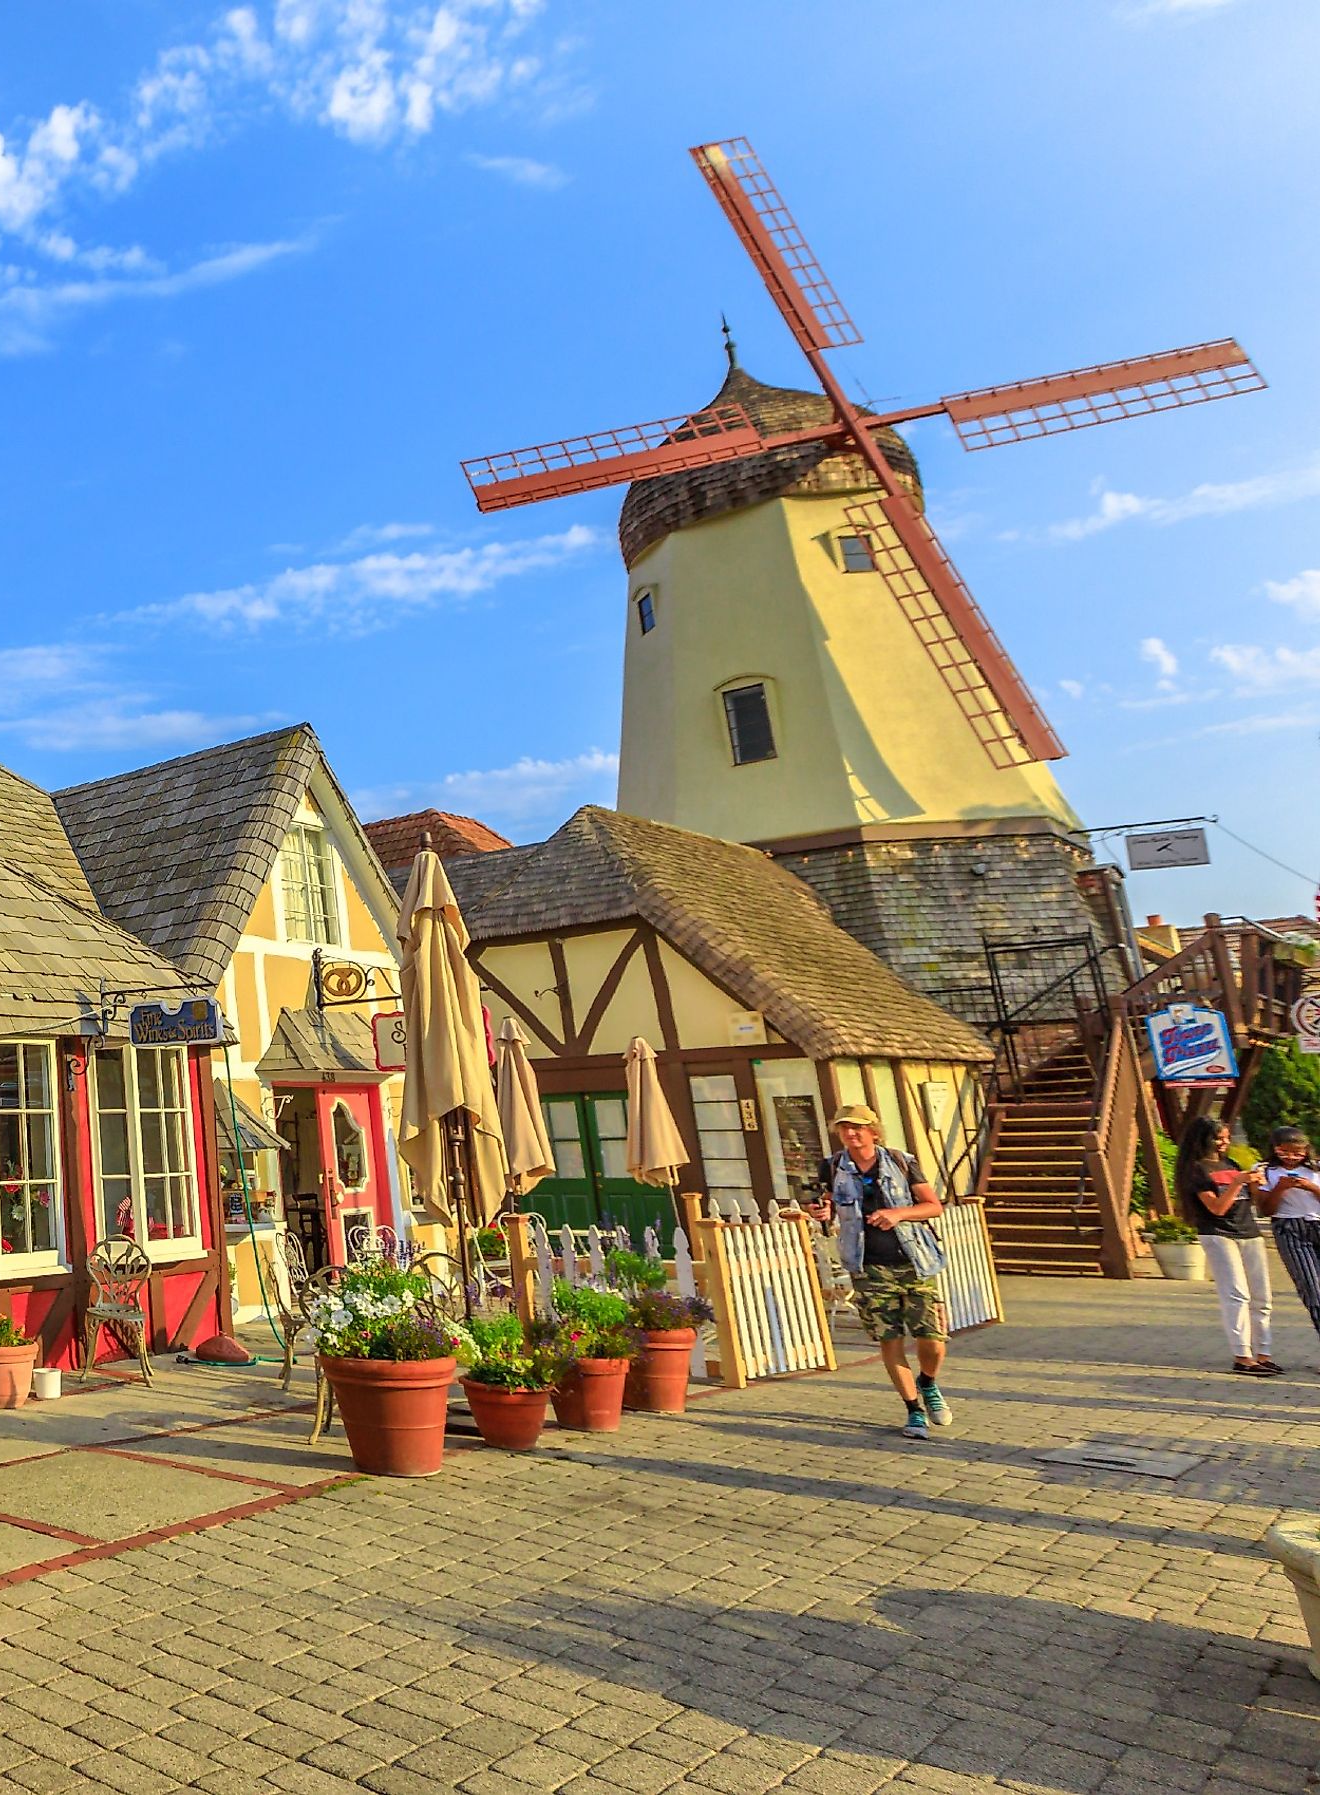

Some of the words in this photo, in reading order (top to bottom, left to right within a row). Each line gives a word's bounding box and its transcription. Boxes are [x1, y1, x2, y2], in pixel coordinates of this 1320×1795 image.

[141, 1009, 163, 1026] Fine
[133, 1023, 169, 1042] Wines
[176, 1021, 215, 1041] Spirits
[321, 1072, 336, 1083] 438
